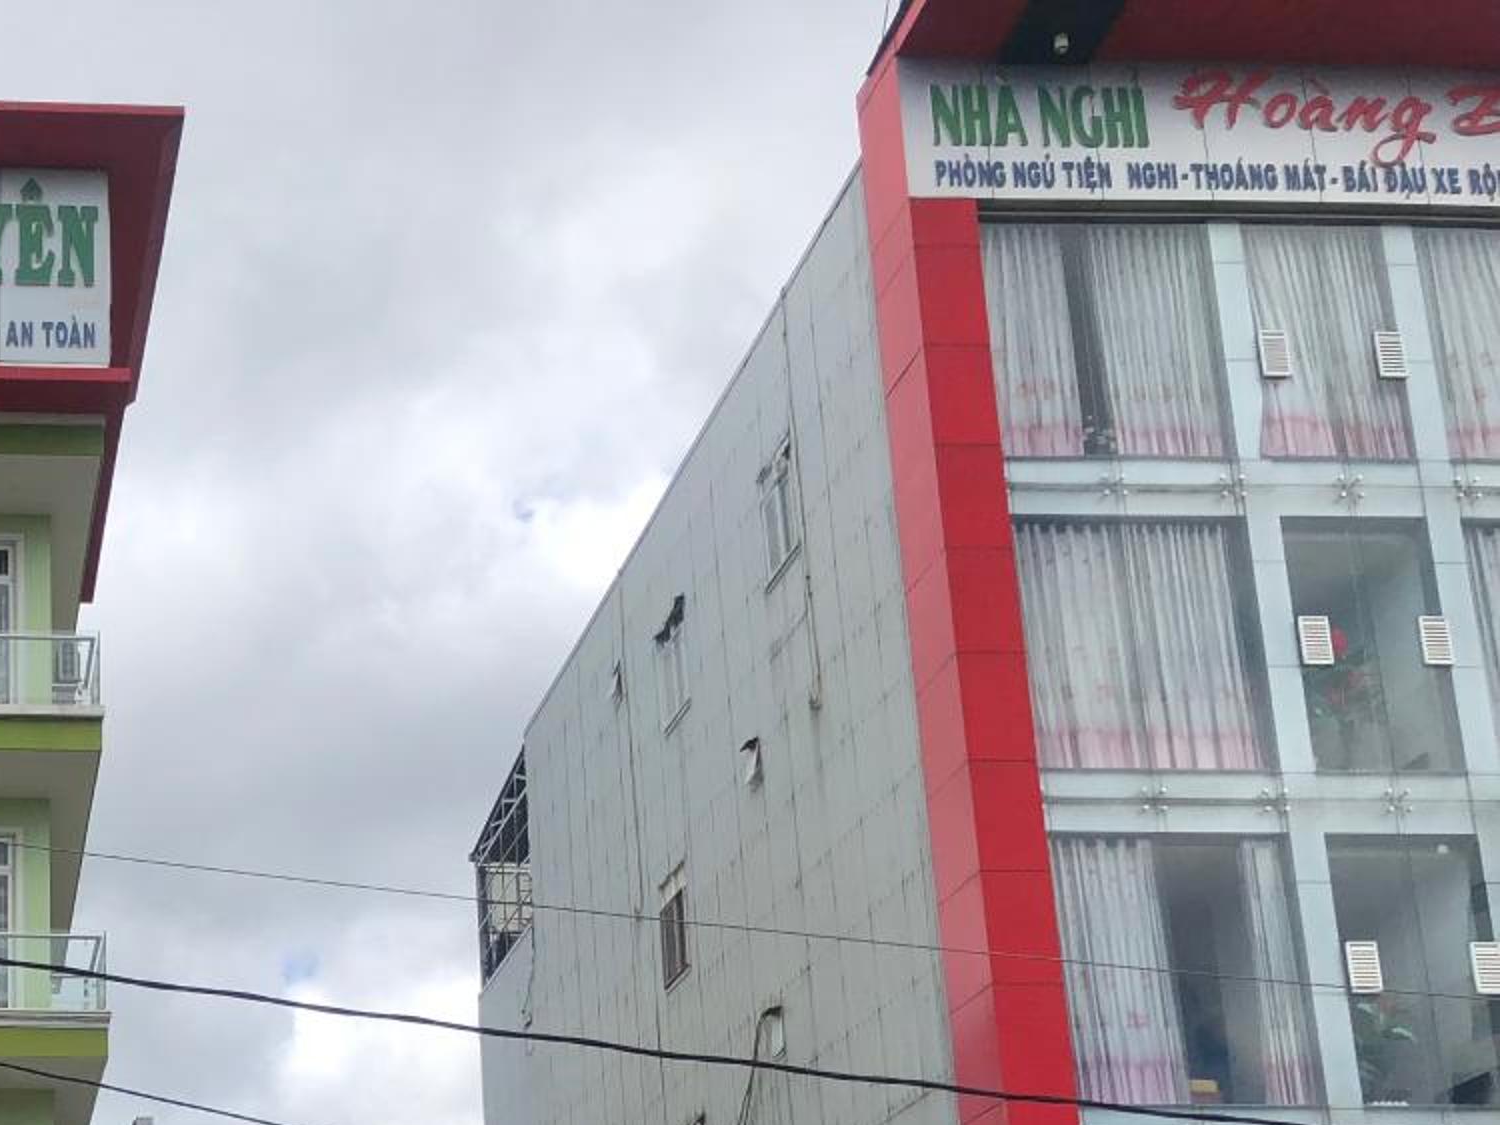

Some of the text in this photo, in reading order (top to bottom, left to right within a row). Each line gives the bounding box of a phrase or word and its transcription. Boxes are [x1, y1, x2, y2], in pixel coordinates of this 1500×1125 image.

[929, 67, 1029, 147] NHÀ
[1172, 65, 1437, 168] Hoàng
[934, 153, 1006, 189] PHÒNG
[1062, 156, 1113, 194] TIỆN
[1127, 161, 1179, 190] NGHI
[1189, 156, 1279, 191] THOÁNG
[1284, 157, 1327, 192] MÁT
[1431, 167, 1462, 195] XE
[1467, 162, 1500, 202] RỘ
[5, 320, 33, 348] AN
[41, 314, 96, 349] TOÀN
